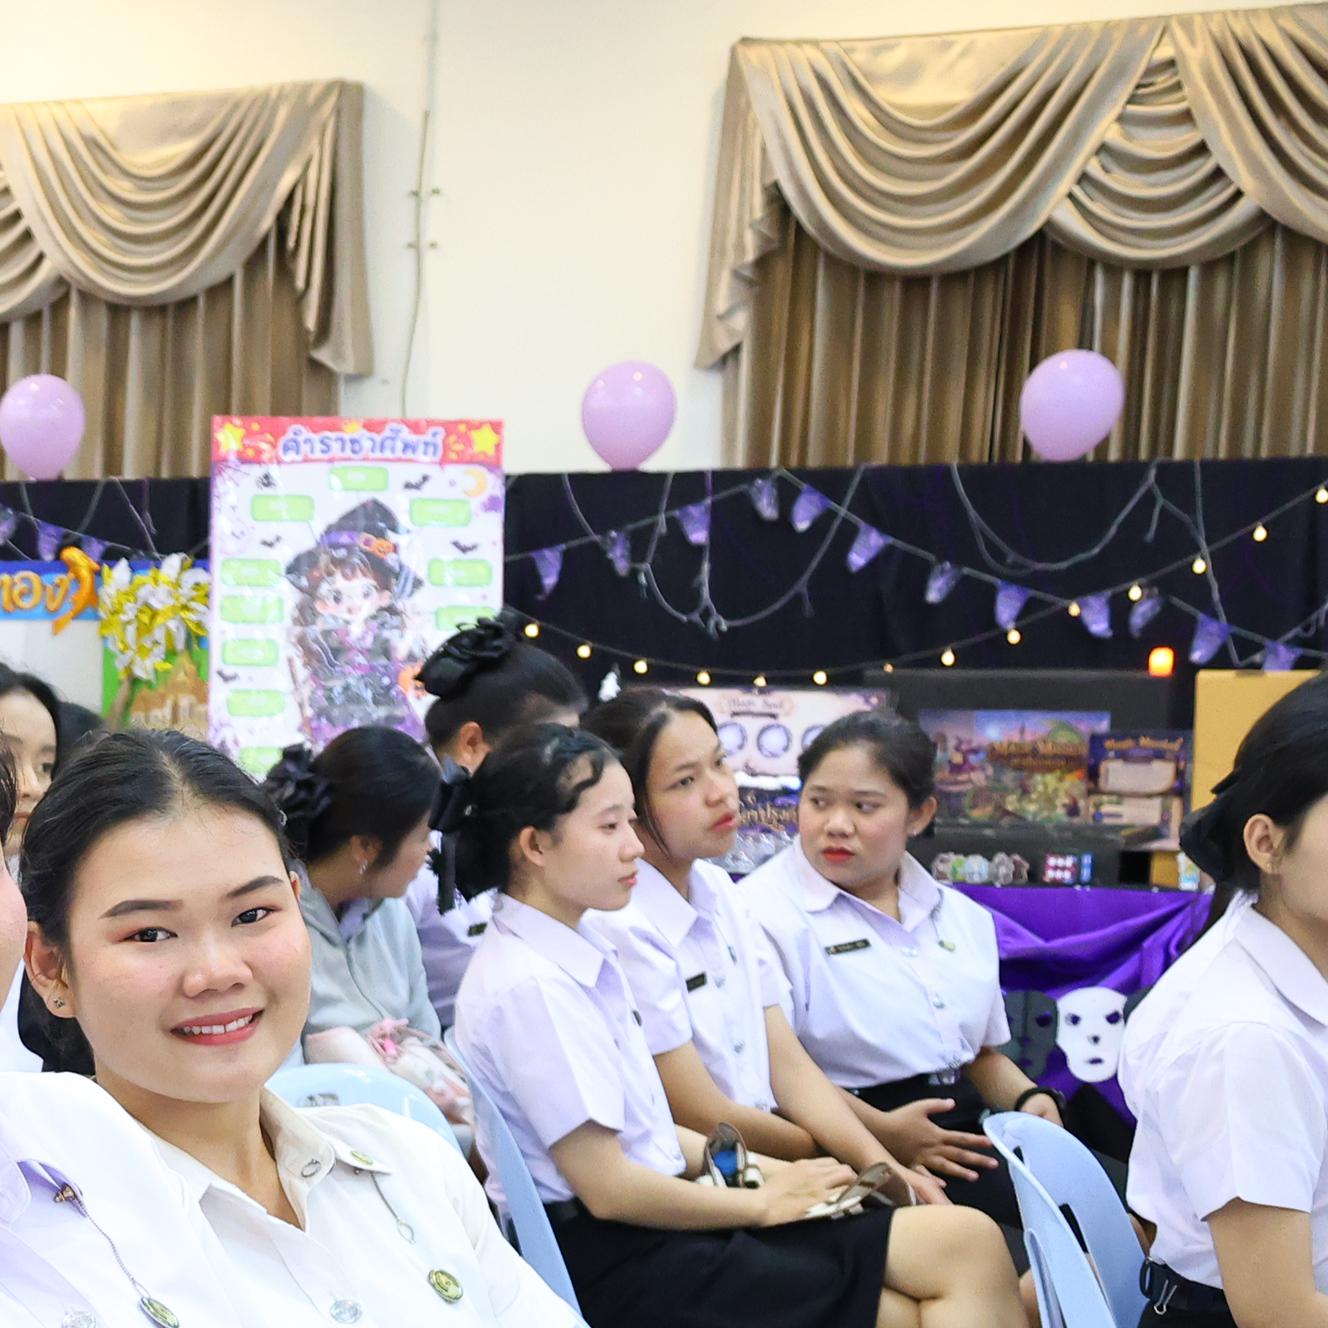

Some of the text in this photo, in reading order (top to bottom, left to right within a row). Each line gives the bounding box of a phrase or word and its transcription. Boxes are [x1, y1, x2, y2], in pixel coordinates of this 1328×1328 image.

[280, 426, 443, 460] คำราชาศัพท์
